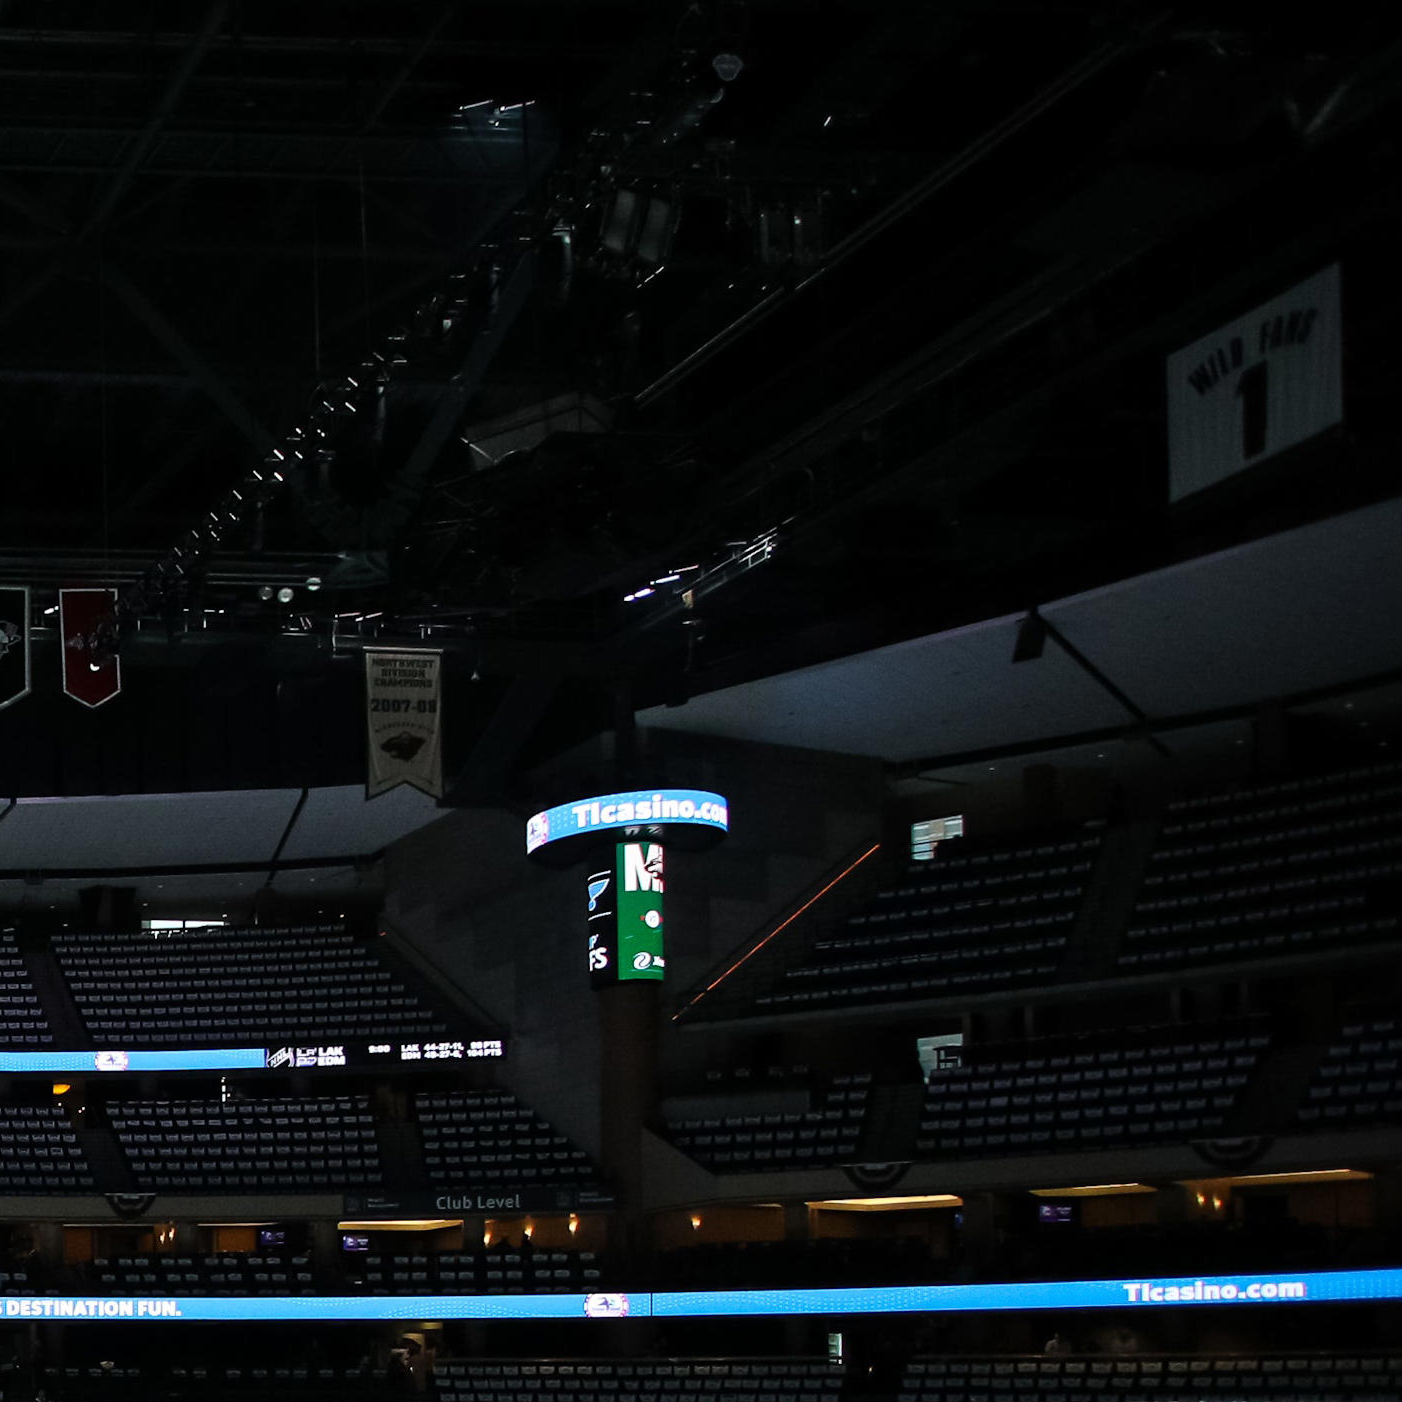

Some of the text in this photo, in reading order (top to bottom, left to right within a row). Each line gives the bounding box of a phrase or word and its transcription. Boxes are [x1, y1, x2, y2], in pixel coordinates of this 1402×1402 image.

[1188, 309, 1315, 396] WILD FANS
[1236, 361, 1267, 458] 1
[318, 1047, 343, 1056] LAK
[318, 1056, 345, 1066] EDM
[436, 1194, 520, 1211] Club Level
[7, 1299, 132, 1317] DESTINATION
[137, 1300, 182, 1317] FUN.
